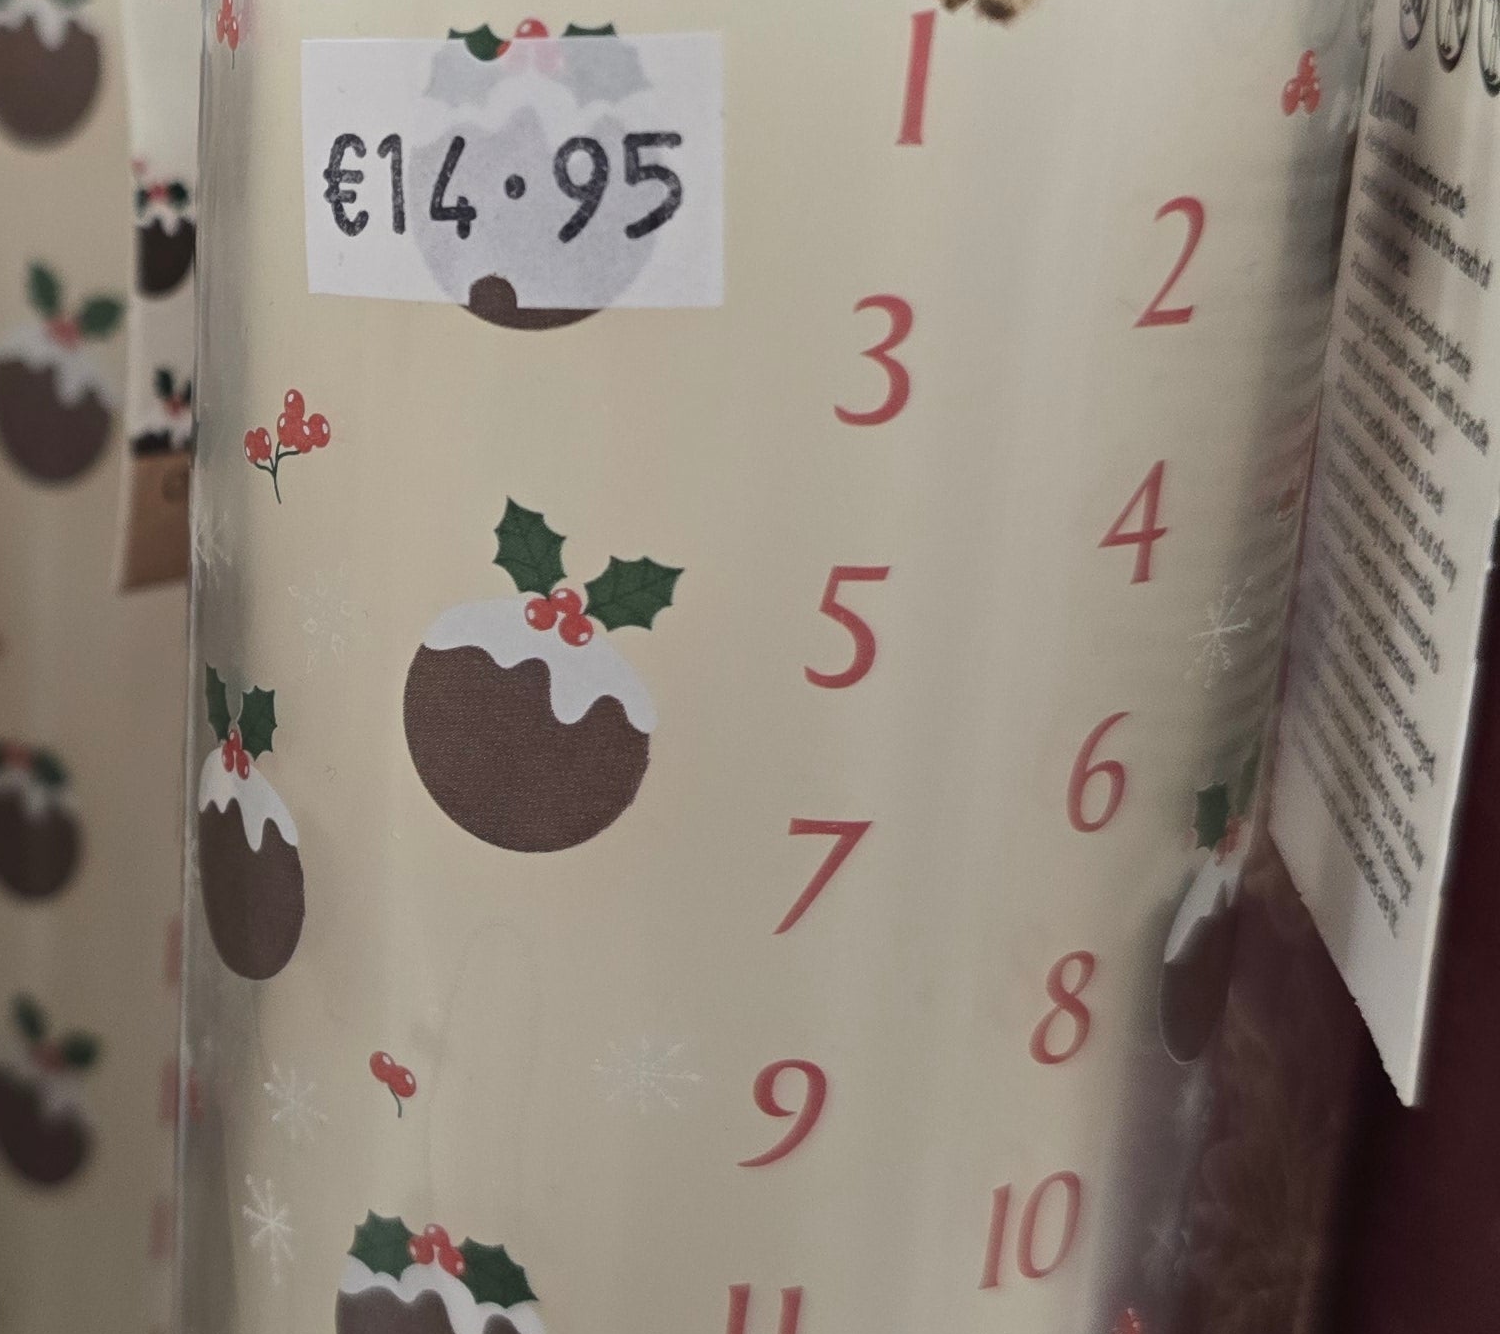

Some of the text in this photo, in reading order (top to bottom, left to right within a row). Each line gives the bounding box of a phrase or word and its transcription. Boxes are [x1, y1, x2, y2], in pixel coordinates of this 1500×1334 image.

[896, 9, 937, 147] 1
[1135, 196, 1205, 328] 2
[833, 295, 915, 426] 3
[1098, 460, 1168, 584] 4
[804, 565, 890, 688] 5
[1066, 712, 1131, 832] 6
[773, 817, 873, 934] 7
[1030, 950, 1096, 1065] 8
[737, 1058, 827, 1168] 9
[979, 1171, 1083, 1290] 10
